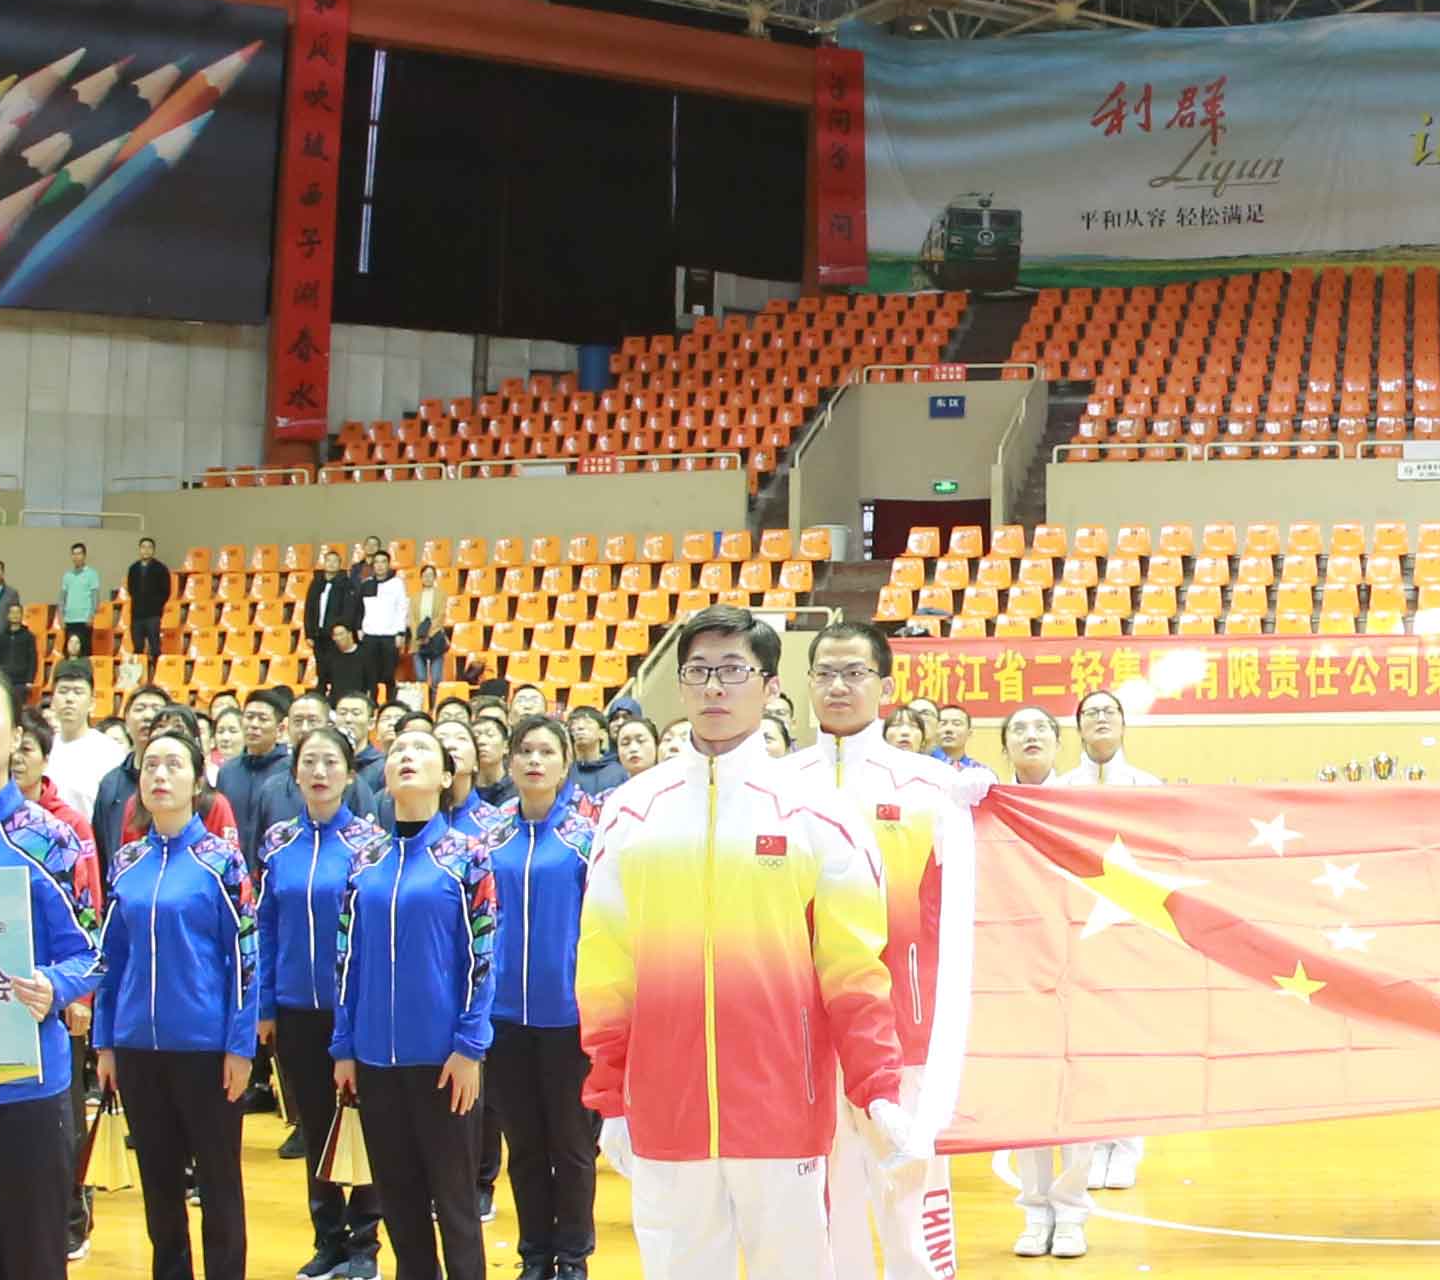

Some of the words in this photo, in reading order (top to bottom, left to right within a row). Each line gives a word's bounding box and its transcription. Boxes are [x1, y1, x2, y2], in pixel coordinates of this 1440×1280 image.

[1091, 75, 1228, 147] 利群
[1148, 124, 1285, 198] Liqun
[1081, 208, 1167, 231] 平和从容
[1175, 203, 1265, 227] 轻松满足
